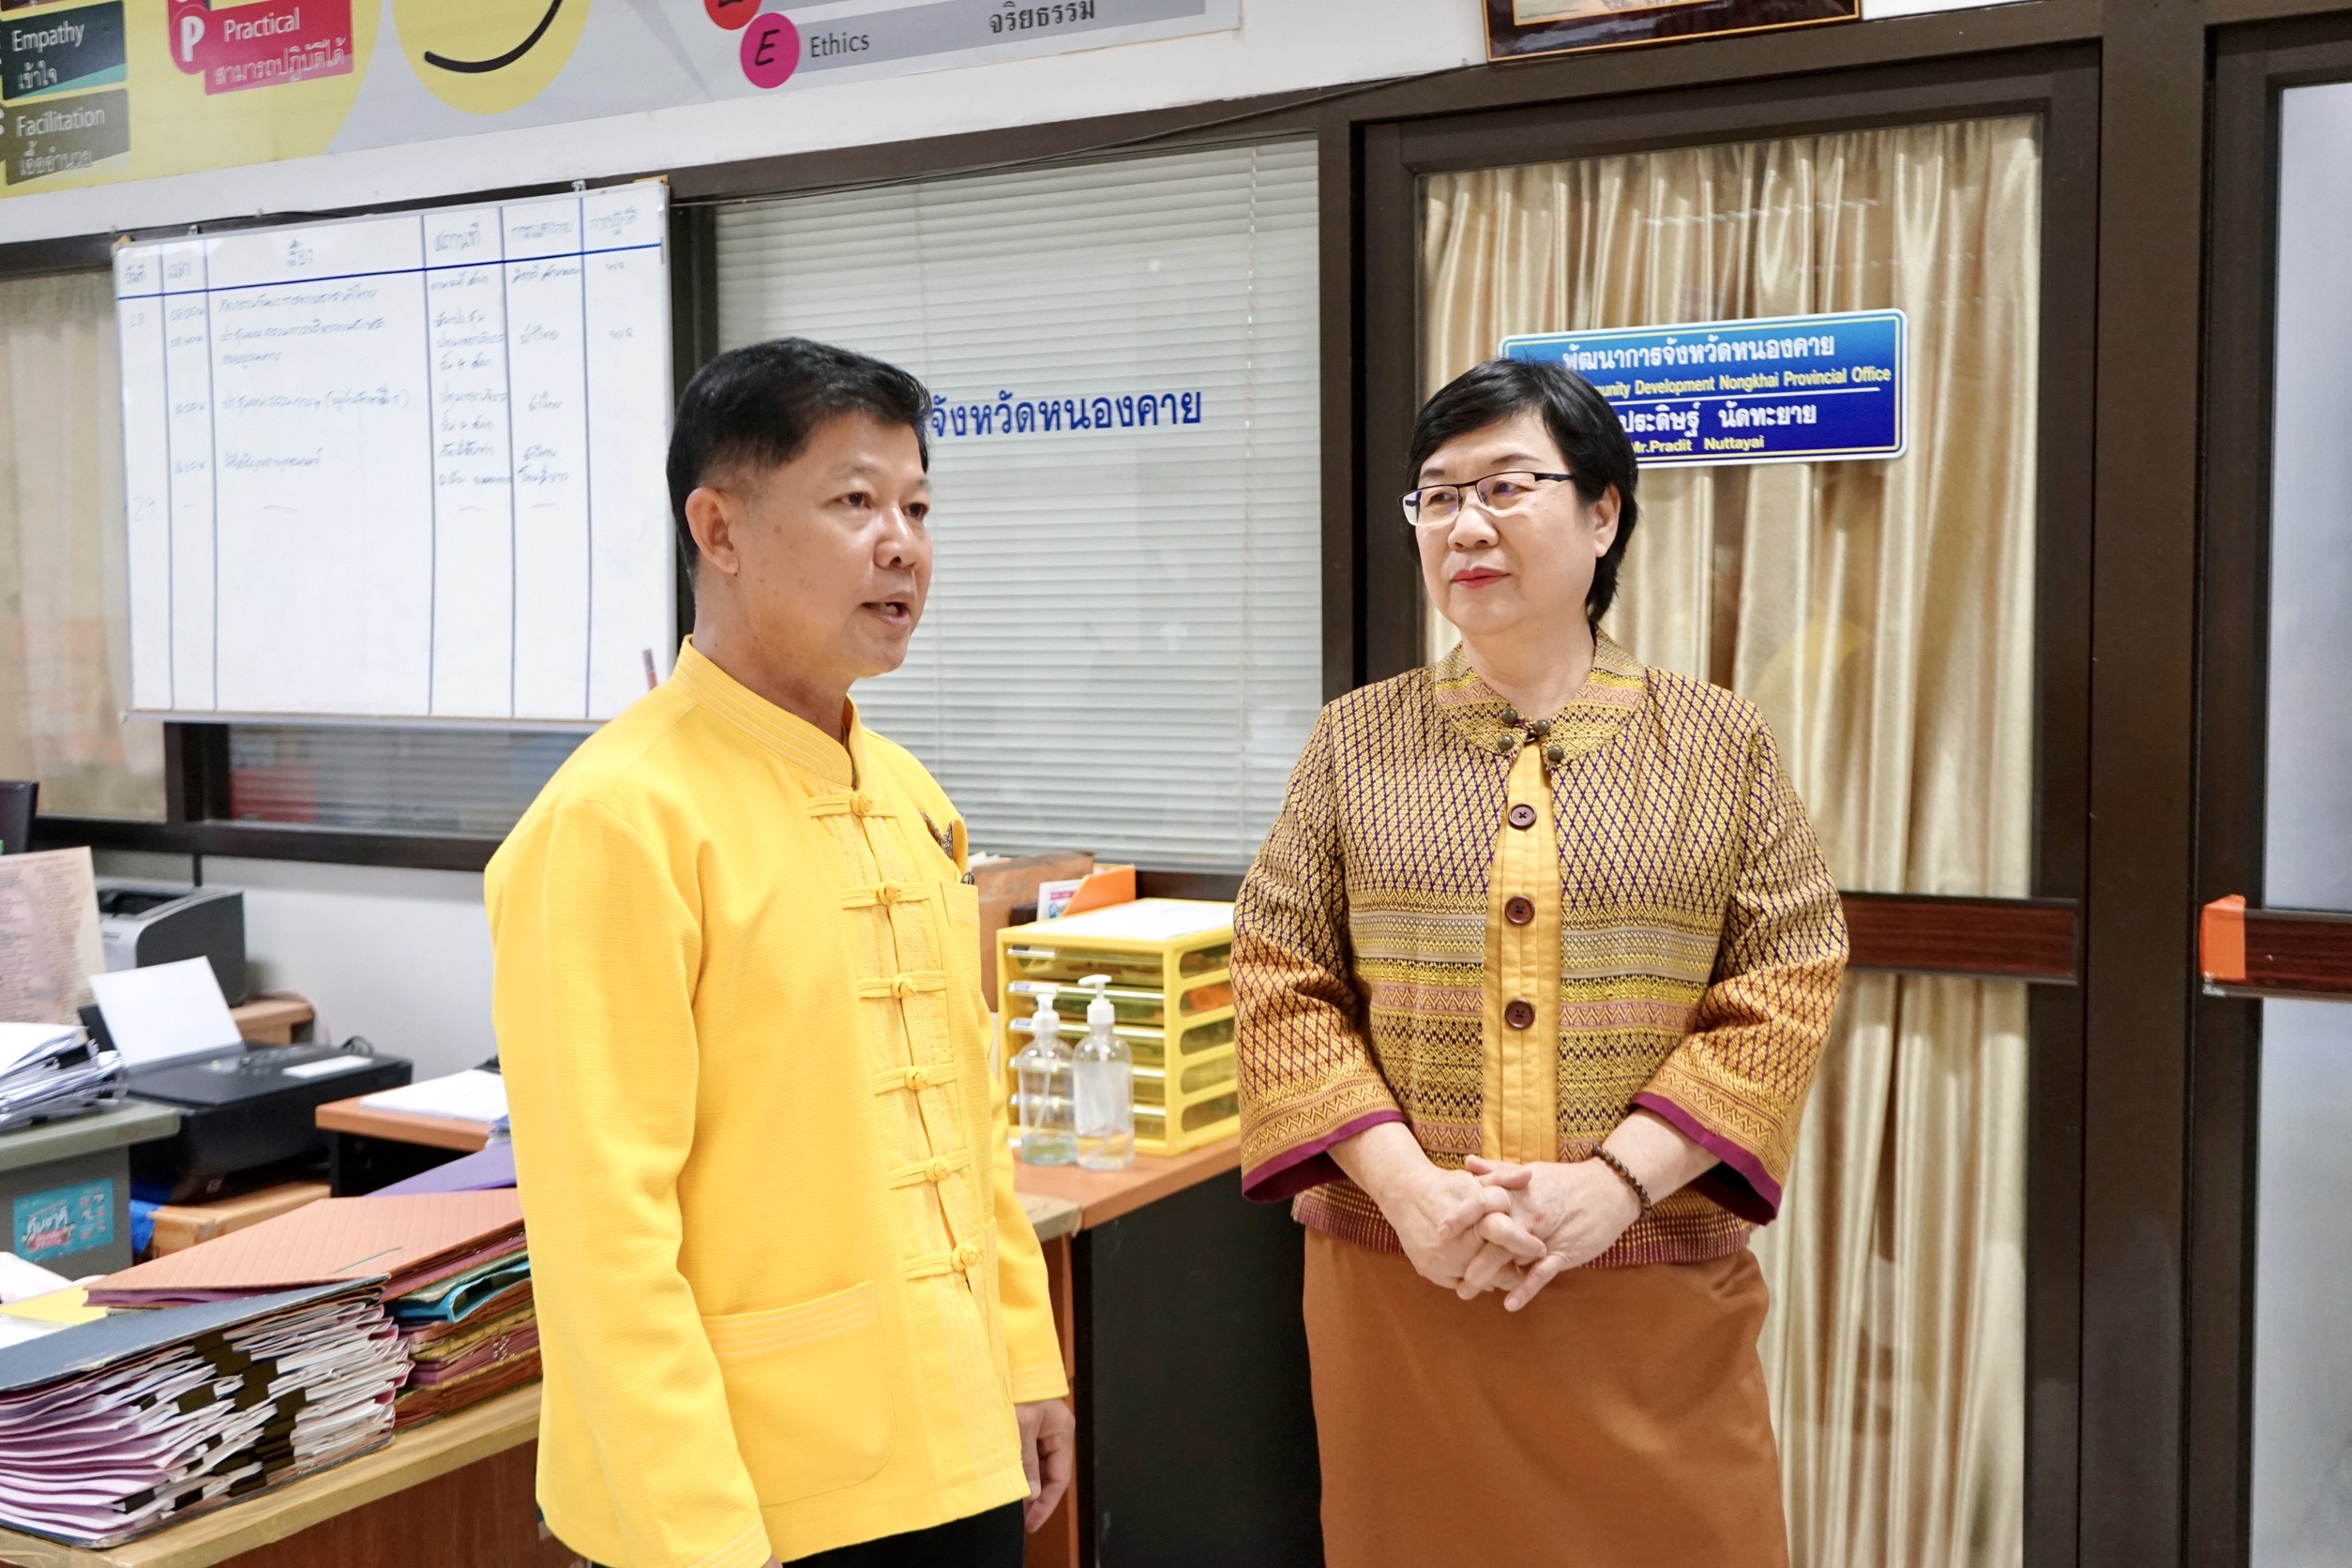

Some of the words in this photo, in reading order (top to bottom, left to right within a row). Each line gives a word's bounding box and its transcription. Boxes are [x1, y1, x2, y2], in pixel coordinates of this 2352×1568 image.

[11, 21, 85, 53] Empathy
[180, 15, 205, 63] P
[223, 8, 301, 42] Practical
[754, 28, 780, 67] E
[810, 32, 870, 58] Ethics
[16, 107, 105, 138] Facilitation
[1562, 334, 1835, 371] พัฒนาการจังหวัดหนองคาย
[1594, 380, 1631, 400] unity
[1635, 377, 1715, 399] Development
[1719, 371, 1780, 392] Nongkhai
[1784, 367, 1847, 387] Provincial
[1852, 366, 1892, 383] Office
[930, 389, 1201, 438] จังหวัดหนองคาย
[1704, 435, 1765, 452] Nuttayai
